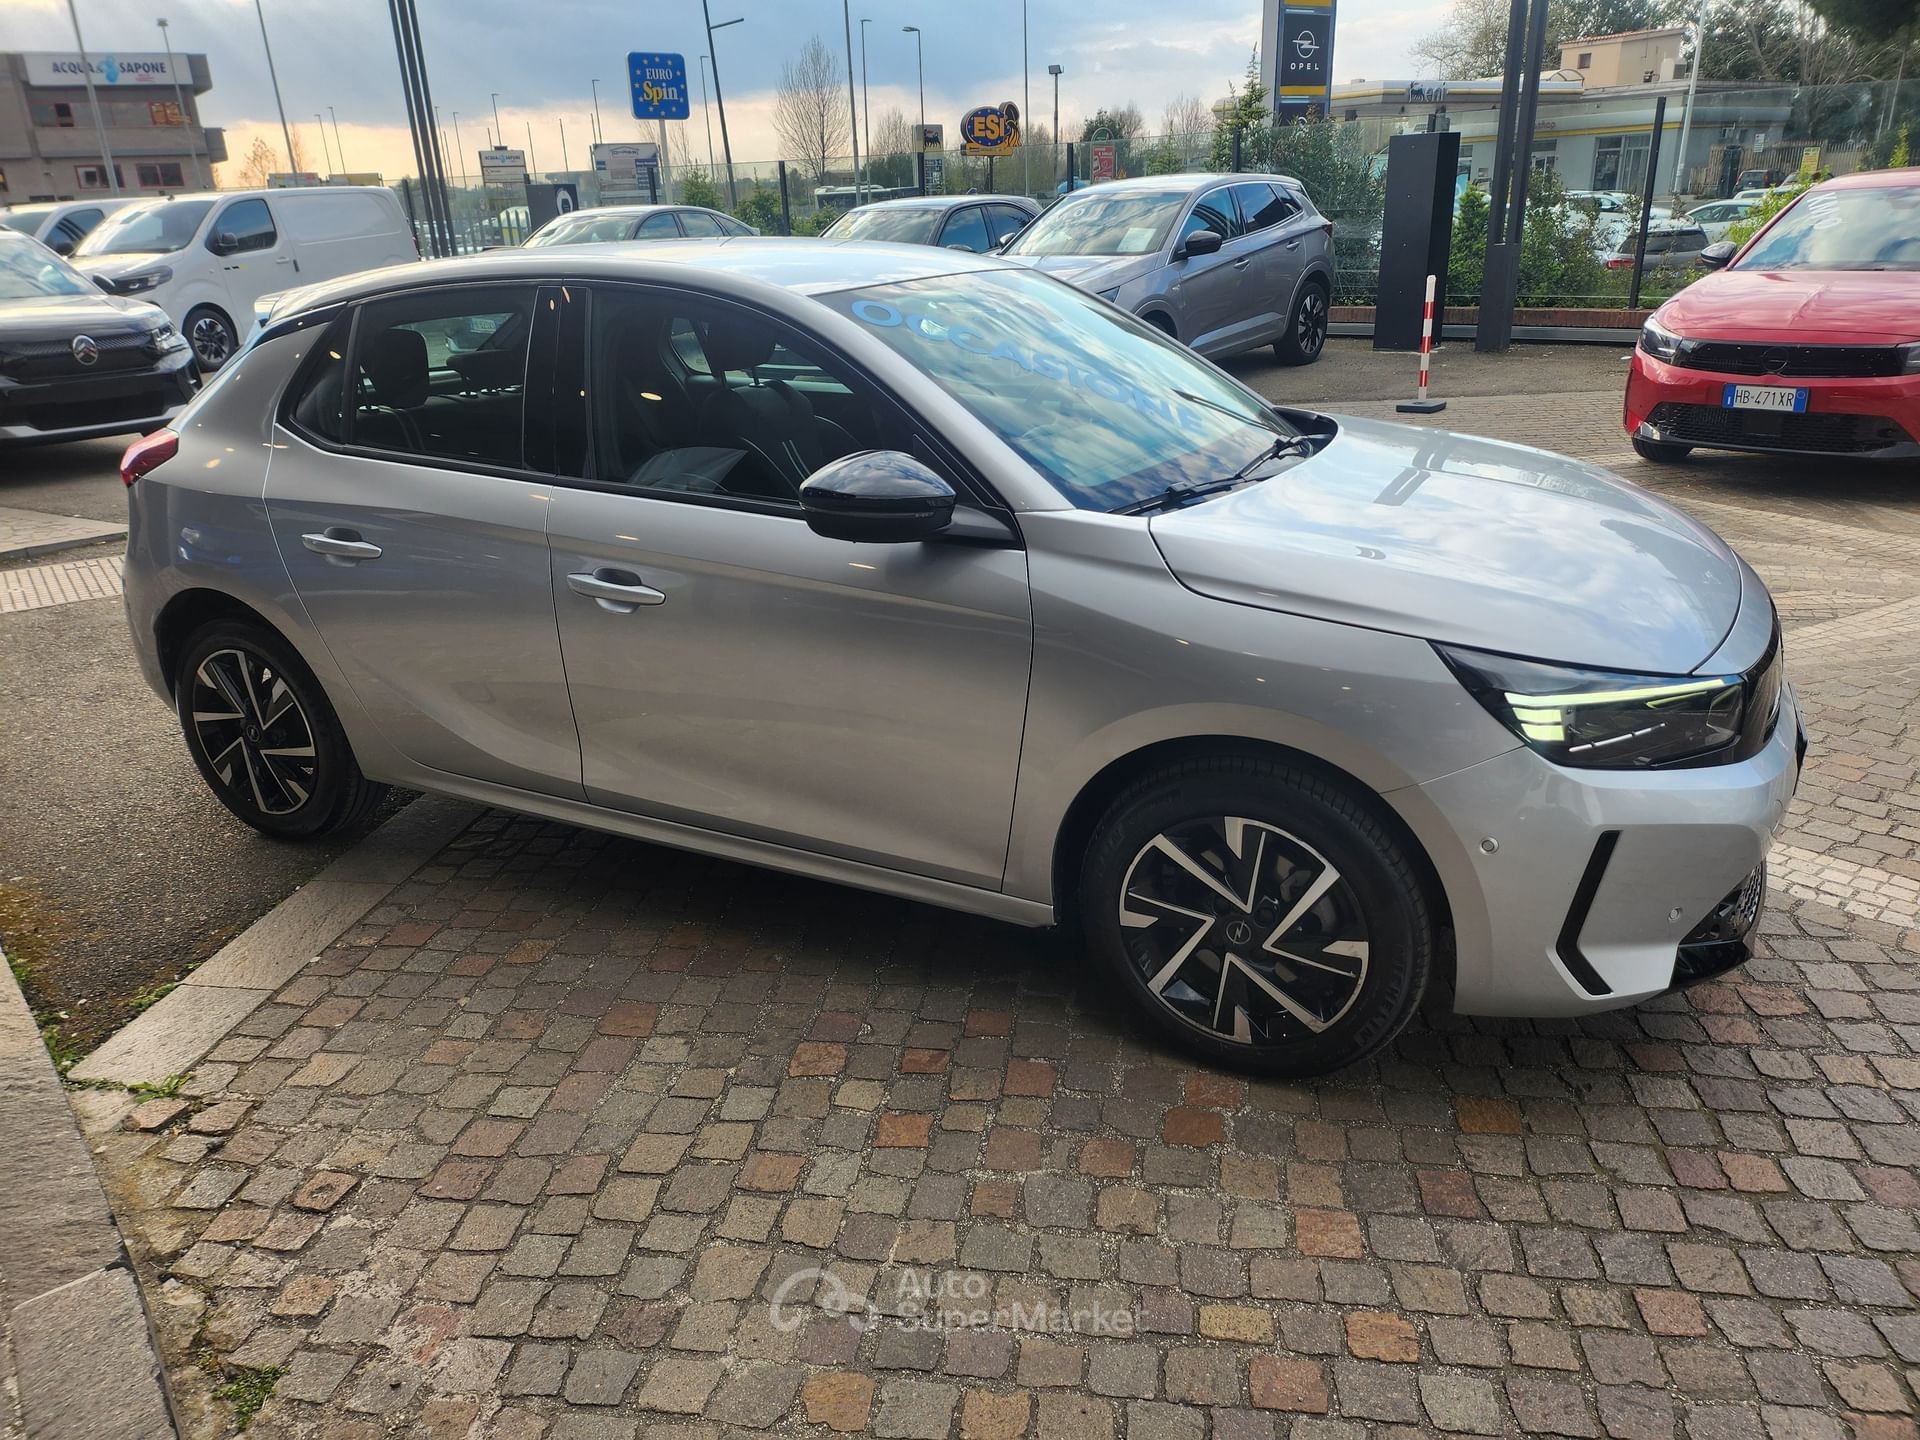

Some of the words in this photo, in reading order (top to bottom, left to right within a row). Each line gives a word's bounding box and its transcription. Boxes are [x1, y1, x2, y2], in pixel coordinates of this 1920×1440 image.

[119, 61, 167, 74] SAPONE
[645, 67, 673, 80] EURO
[1290, 62, 1320, 71] OPEL
[643, 80, 680, 105] Spin
[974, 114, 1005, 140] ESI
[851, 300, 1206, 434] OCCASIONE
